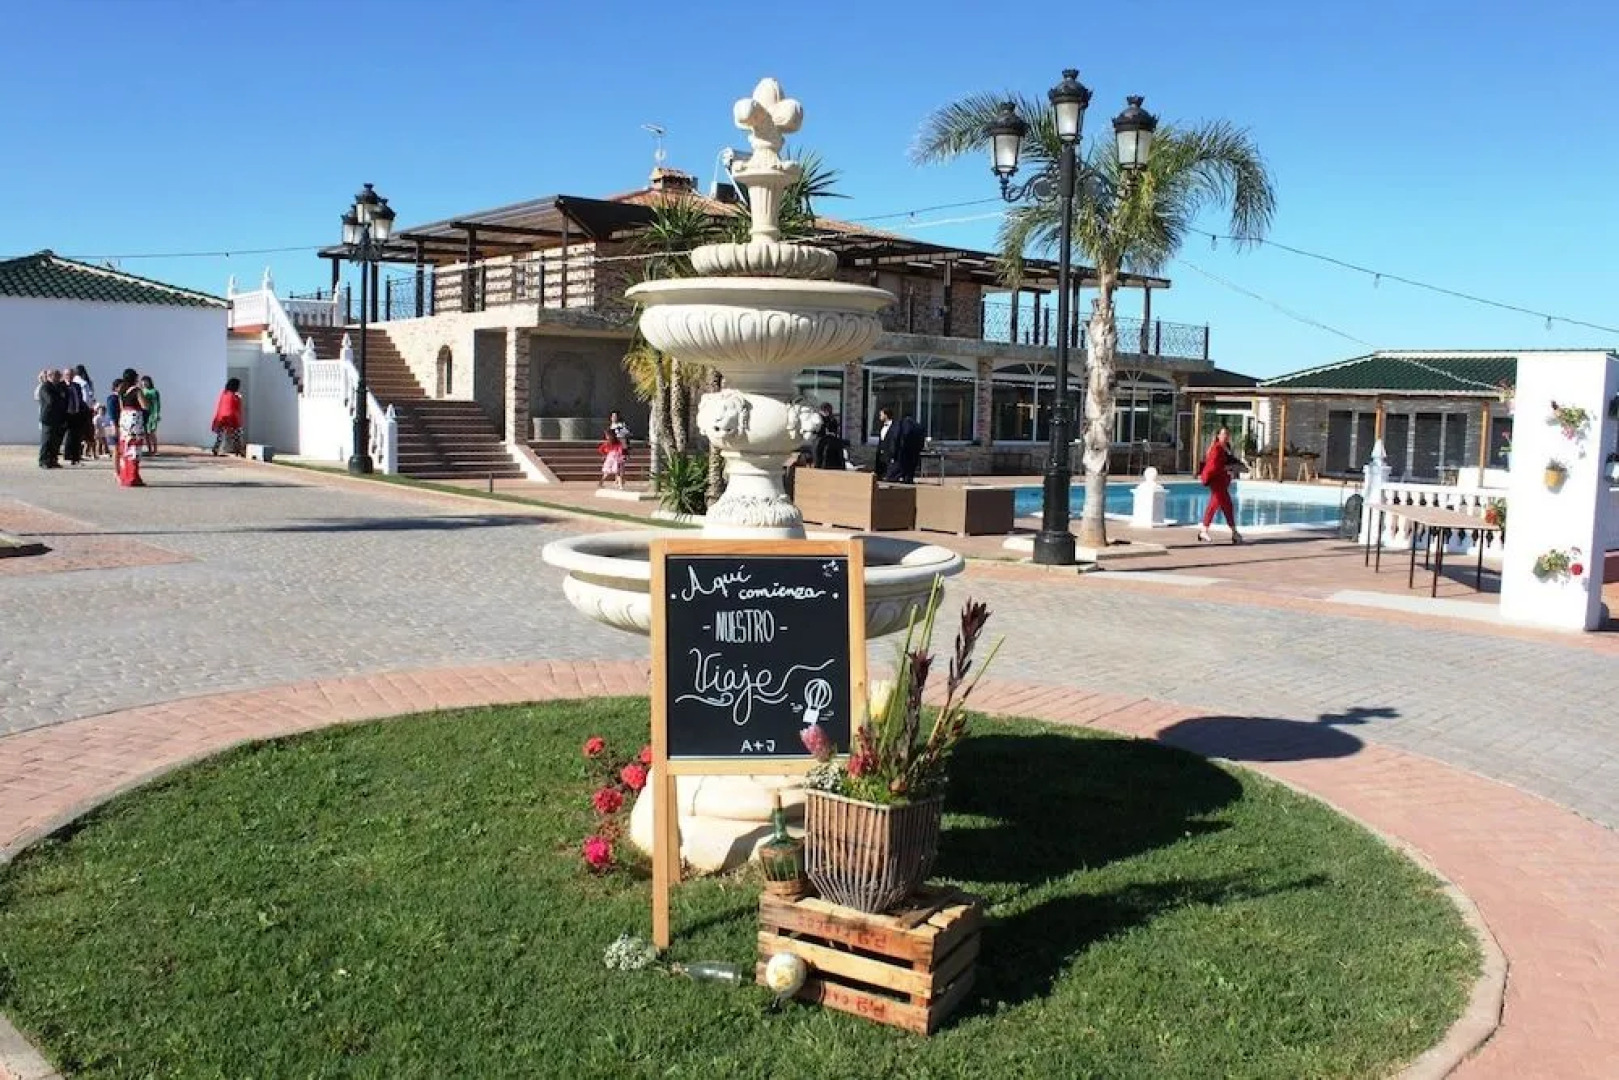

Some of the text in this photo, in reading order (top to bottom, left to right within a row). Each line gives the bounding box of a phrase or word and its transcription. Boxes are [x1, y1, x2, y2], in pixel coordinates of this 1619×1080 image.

[682, 565, 826, 601] Aquí comienza
[689, 648, 782, 725] Viaje
